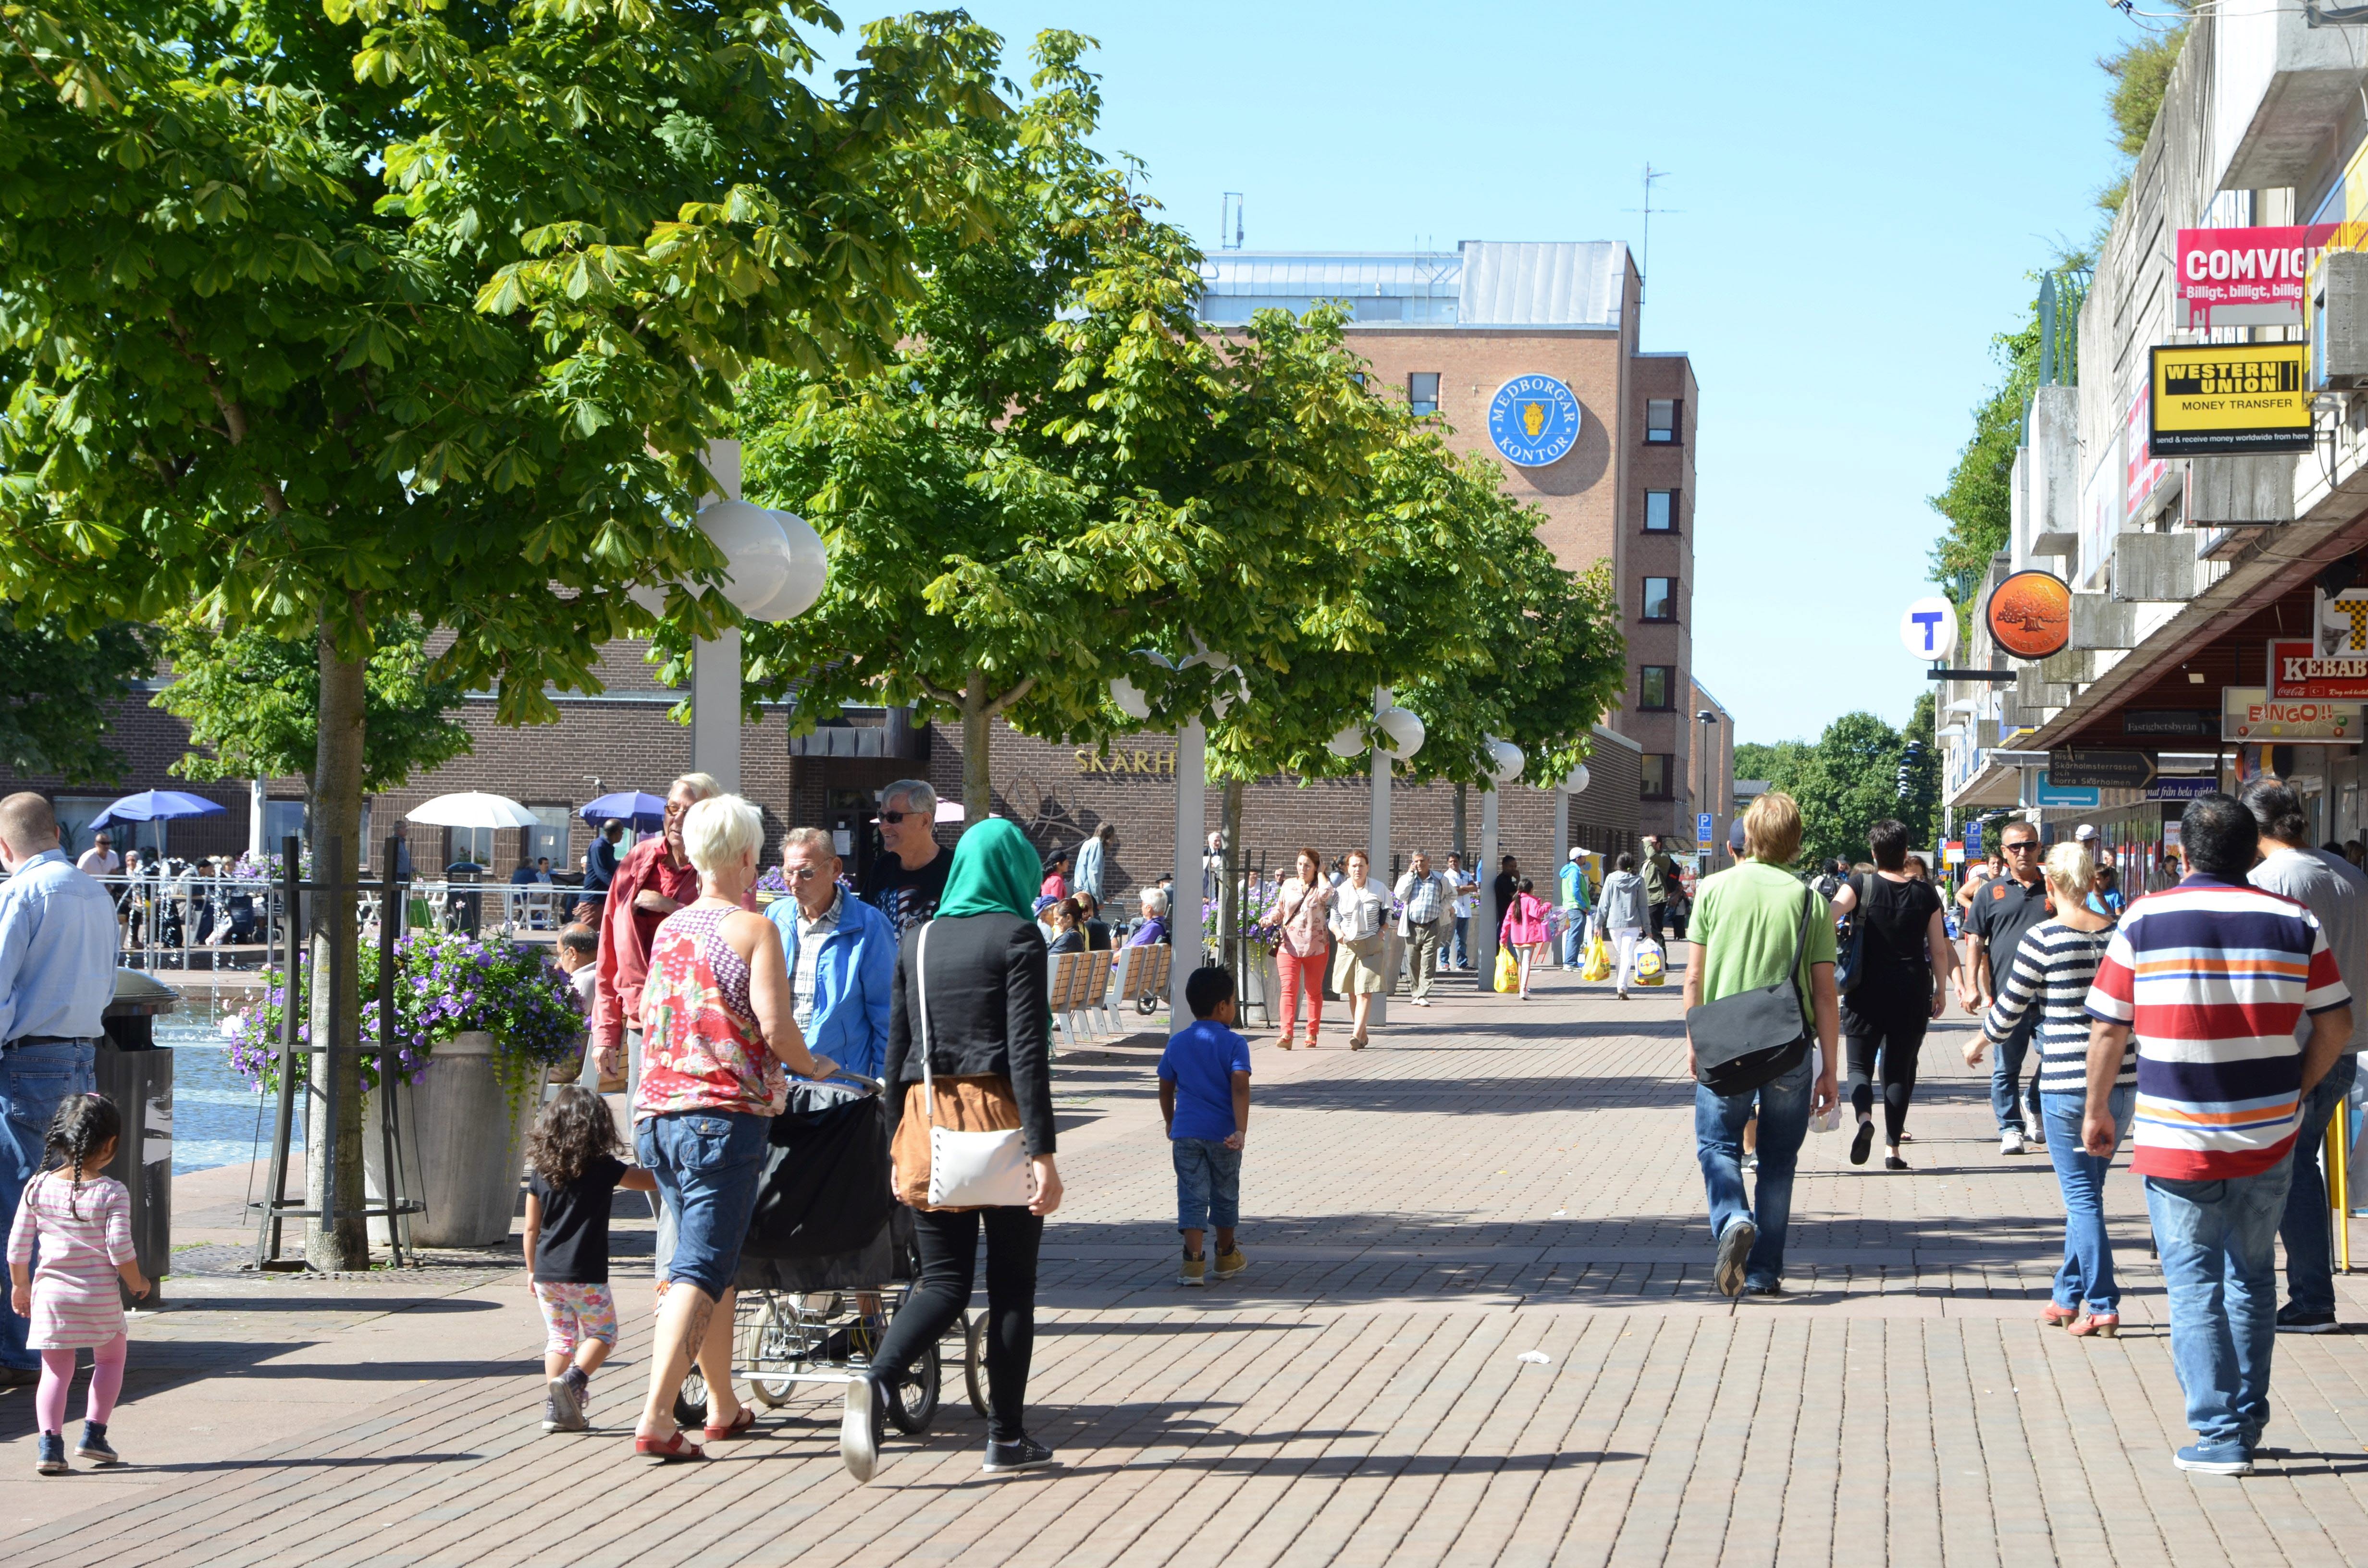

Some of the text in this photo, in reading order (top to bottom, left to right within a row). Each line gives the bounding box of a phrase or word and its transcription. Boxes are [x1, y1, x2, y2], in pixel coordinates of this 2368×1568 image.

[2186, 285, 2227, 301] Billigt,
[2230, 284, 2269, 300] billigt,
[2166, 362, 2276, 380] WESTERN
[2201, 377, 2276, 393] UNION
[1492, 378, 1575, 423] MEDBORGAR
[2182, 399, 2292, 410] MONEY TRANSFER
[1499, 436, 1569, 461] KONTOR
[1912, 612, 1942, 650] T
[2004, 631, 2034, 649] SINCE
[2283, 658, 2368, 681] KEBAB
[2128, 722, 2196, 732] Fastighetsbyrån
[2055, 762, 2137, 771] Skärholmsterrassen
[2081, 777, 2130, 786] Skärholmen
[2159, 786, 2176, 799] från
[1701, 815, 1709, 826] P
[1970, 823, 1978, 834] P
[1993, 885, 2005, 900] 6
